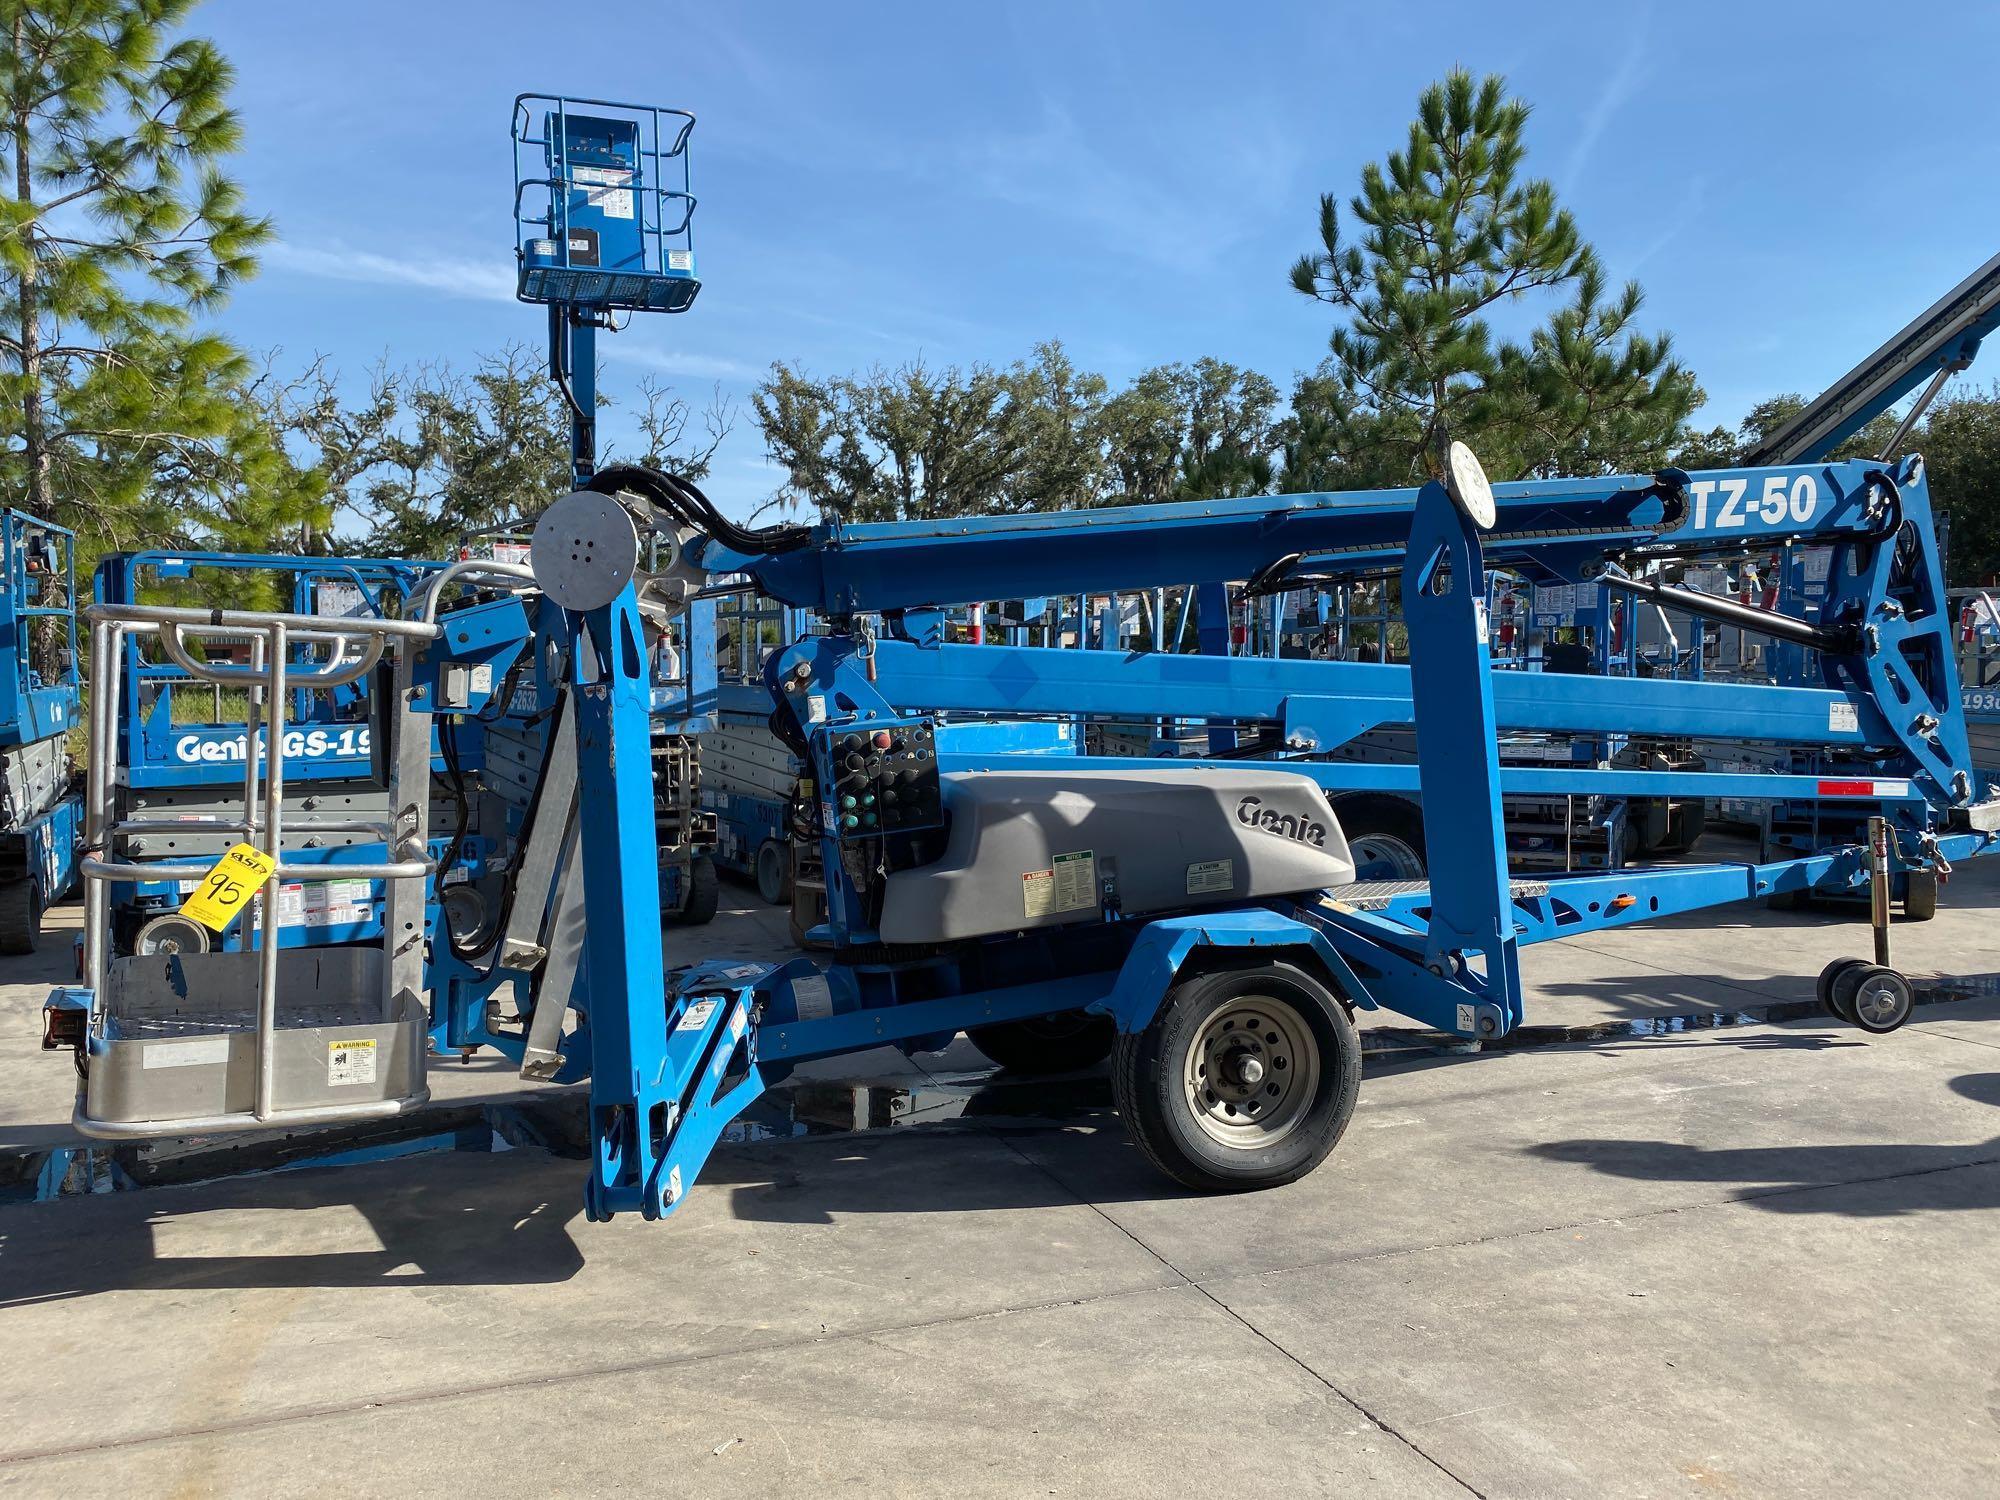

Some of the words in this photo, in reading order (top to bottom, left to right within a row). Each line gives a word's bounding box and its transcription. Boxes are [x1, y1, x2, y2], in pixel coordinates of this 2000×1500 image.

[1690, 475, 1817, 529] TZ-50
[1236, 796, 1326, 848] Genie
[207, 873, 245, 905] 95
